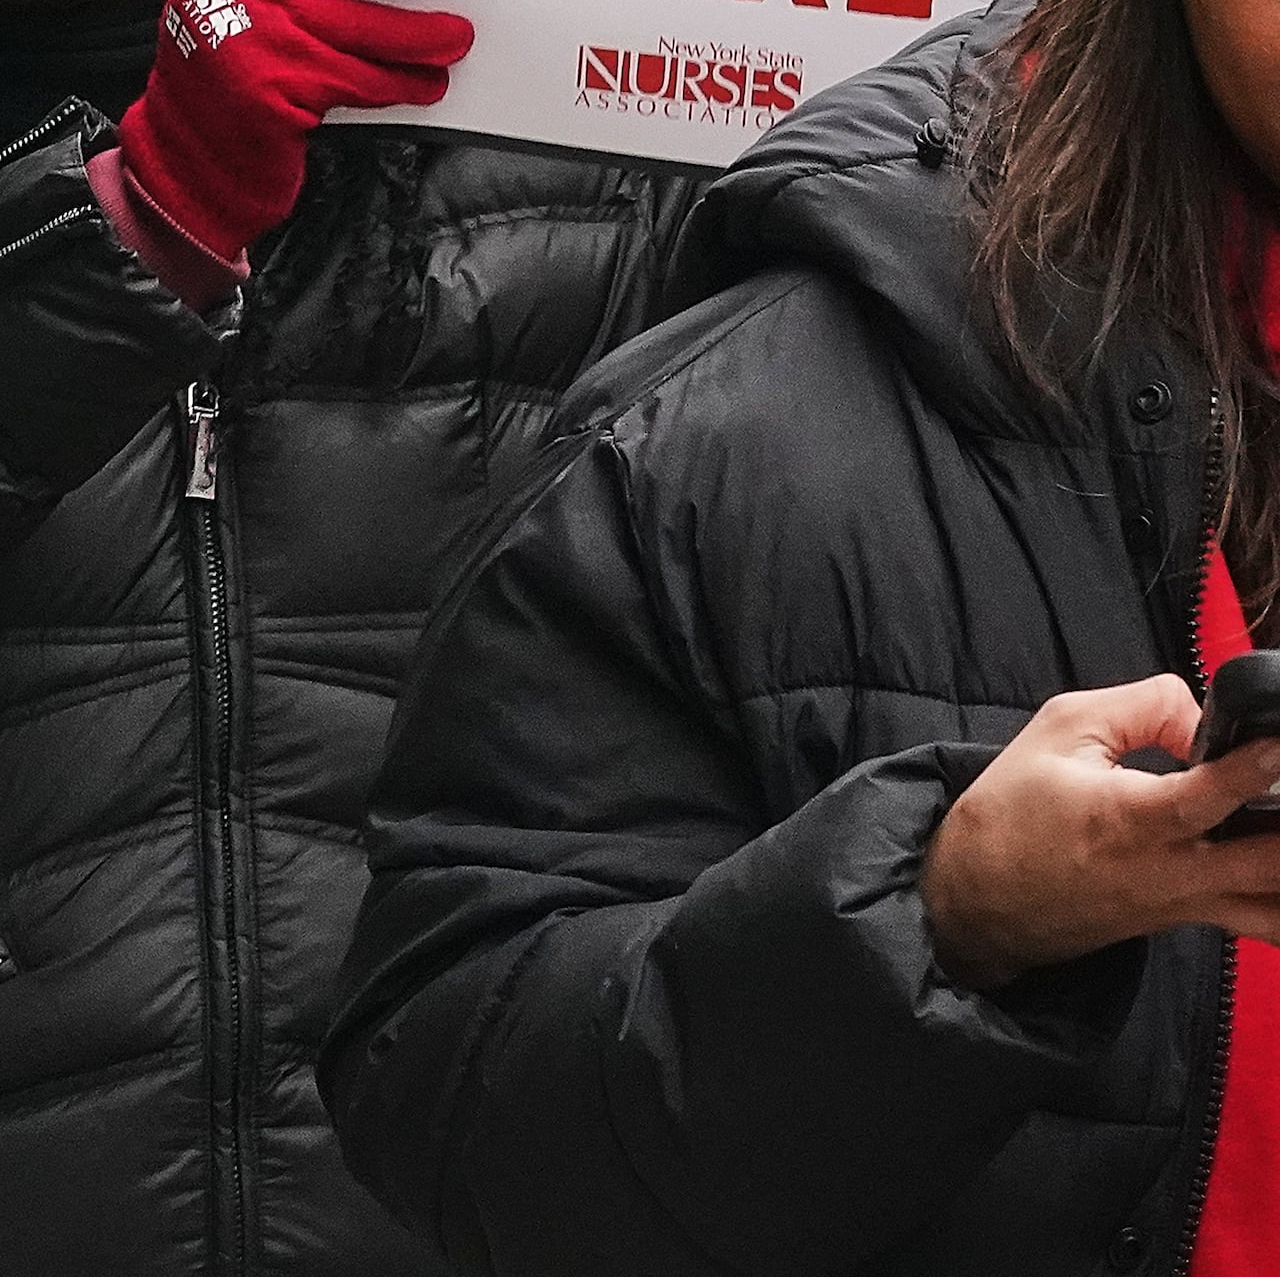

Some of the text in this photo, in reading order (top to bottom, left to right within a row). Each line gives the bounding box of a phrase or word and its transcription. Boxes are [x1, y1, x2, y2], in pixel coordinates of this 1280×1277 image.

[658, 35, 804, 70] New York State
[576, 44, 804, 112] NURSES
[574, 88, 777, 130] ASSOCIATIO
